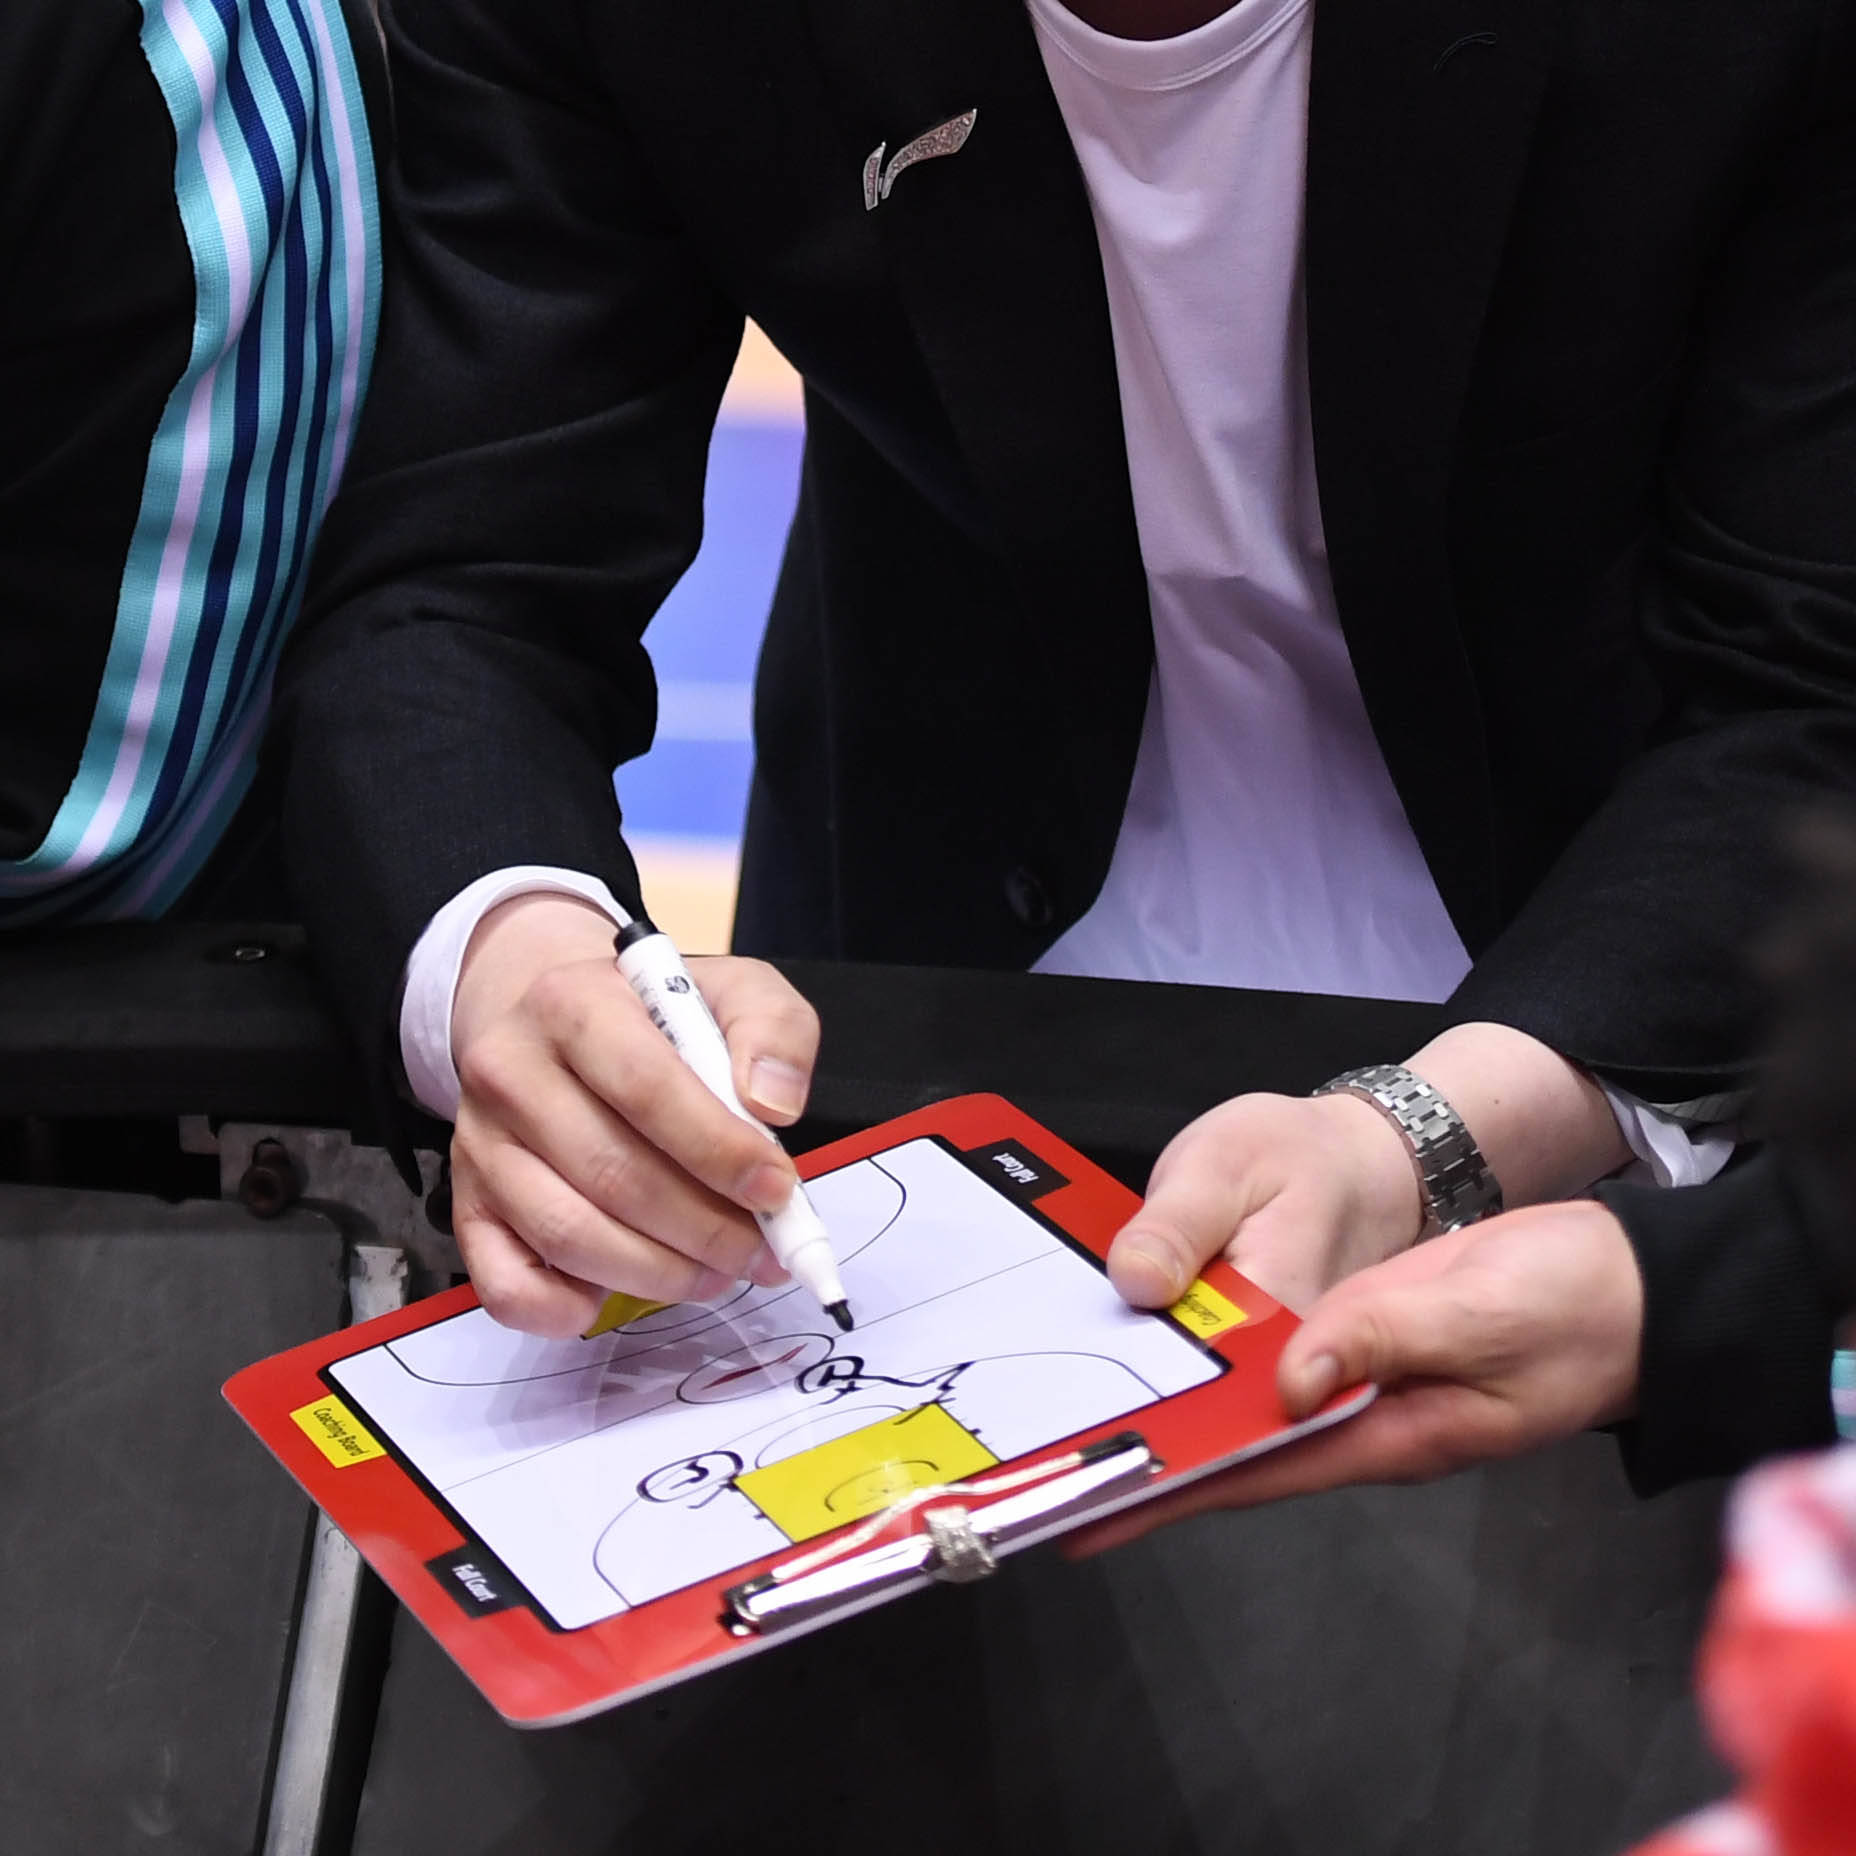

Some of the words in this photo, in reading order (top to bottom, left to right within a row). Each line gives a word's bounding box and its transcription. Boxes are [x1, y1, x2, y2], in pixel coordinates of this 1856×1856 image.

[992, 1152, 1025, 1173] Court
[1008, 1168, 1040, 1184] Full
[312, 1407, 348, 1440] Coaching
[338, 1434, 371, 1457] Board
[451, 1563, 483, 1582] Full
[464, 1577, 498, 1603] Court
